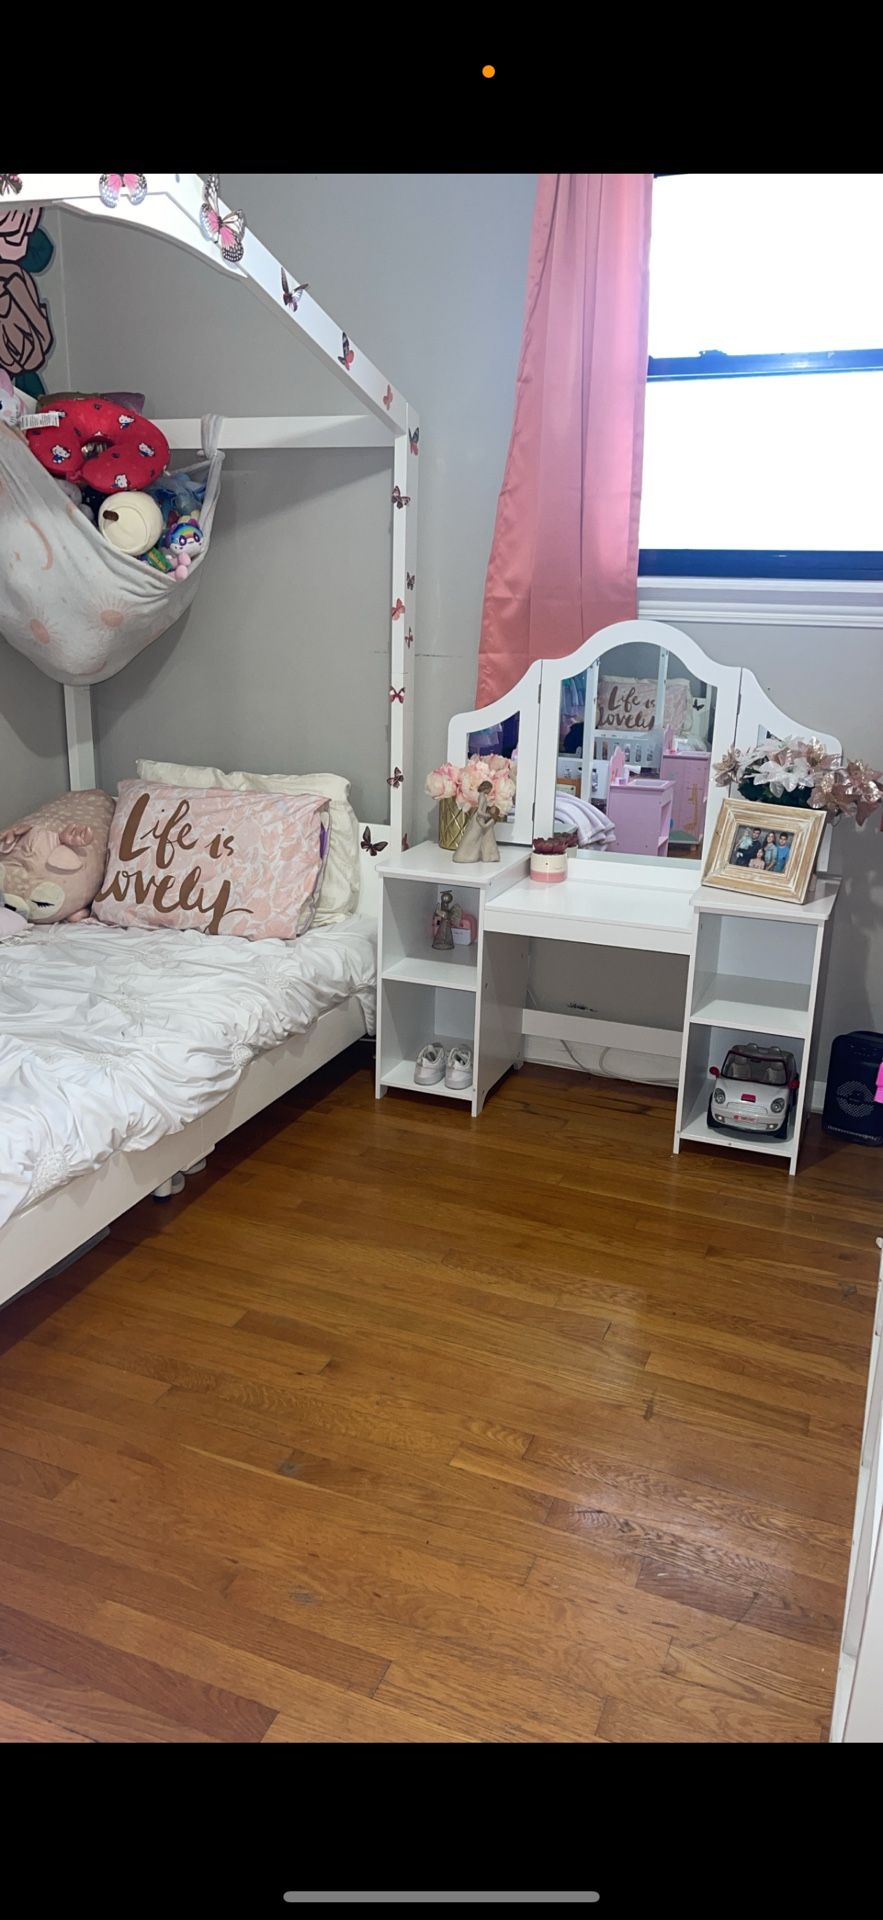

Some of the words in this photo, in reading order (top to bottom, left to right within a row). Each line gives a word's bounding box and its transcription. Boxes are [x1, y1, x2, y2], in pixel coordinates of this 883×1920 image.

[609, 686, 640, 712] Life
[119, 793, 198, 868] Life
[205, 828, 234, 859] is
